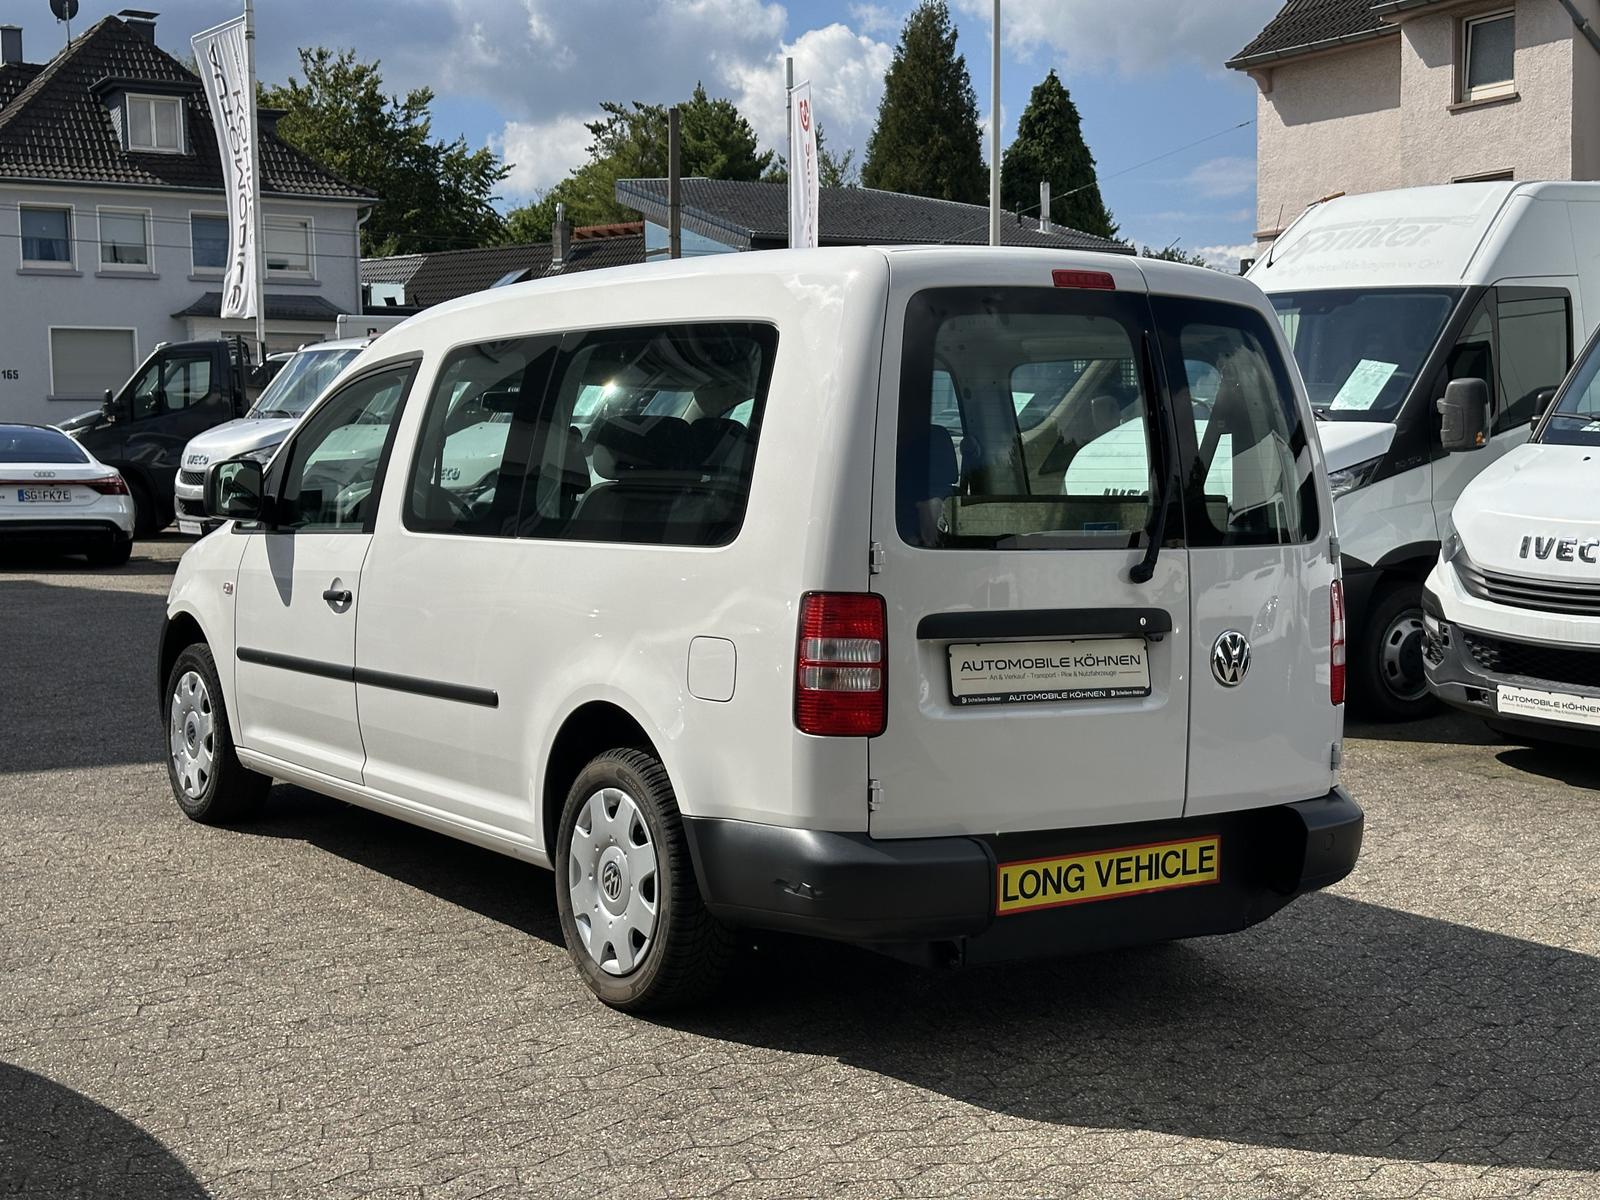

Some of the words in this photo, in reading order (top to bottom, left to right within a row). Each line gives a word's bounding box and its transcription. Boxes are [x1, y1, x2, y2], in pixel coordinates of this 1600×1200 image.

[1, 369, 19, 380] 165
[24, 489, 38, 501] SG
[960, 657, 1071, 672] AUTOMOBILE
[1074, 653, 1141, 668] KÖHNEN
[1008, 691, 1068, 701] AUTOMOBILE
[1502, 694, 1560, 707] AUTOMOBILE
[1002, 863, 1085, 903] LONG
[1095, 845, 1215, 888] VEHICLE
